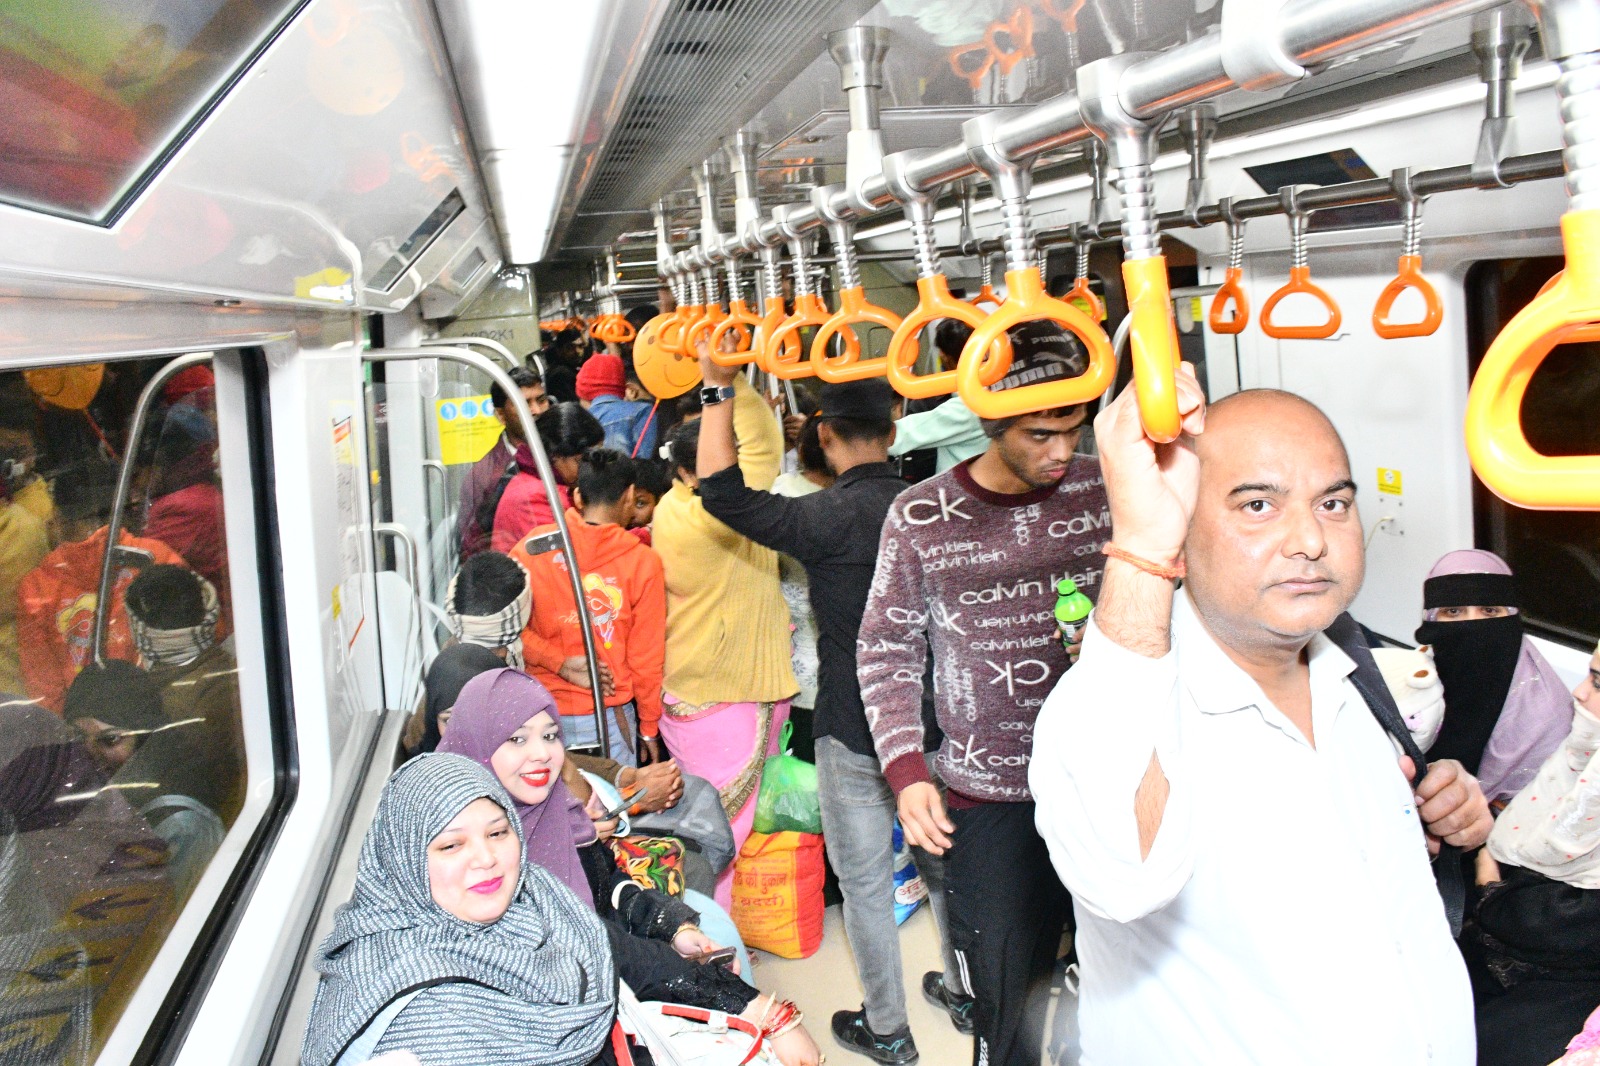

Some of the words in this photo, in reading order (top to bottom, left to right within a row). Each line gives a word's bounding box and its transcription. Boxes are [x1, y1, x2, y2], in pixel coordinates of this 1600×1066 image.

[1047, 505, 1112, 538] calvi
[970, 548, 1007, 565] klein
[959, 578, 1044, 605] calvin
[970, 638, 1020, 652] calvin
